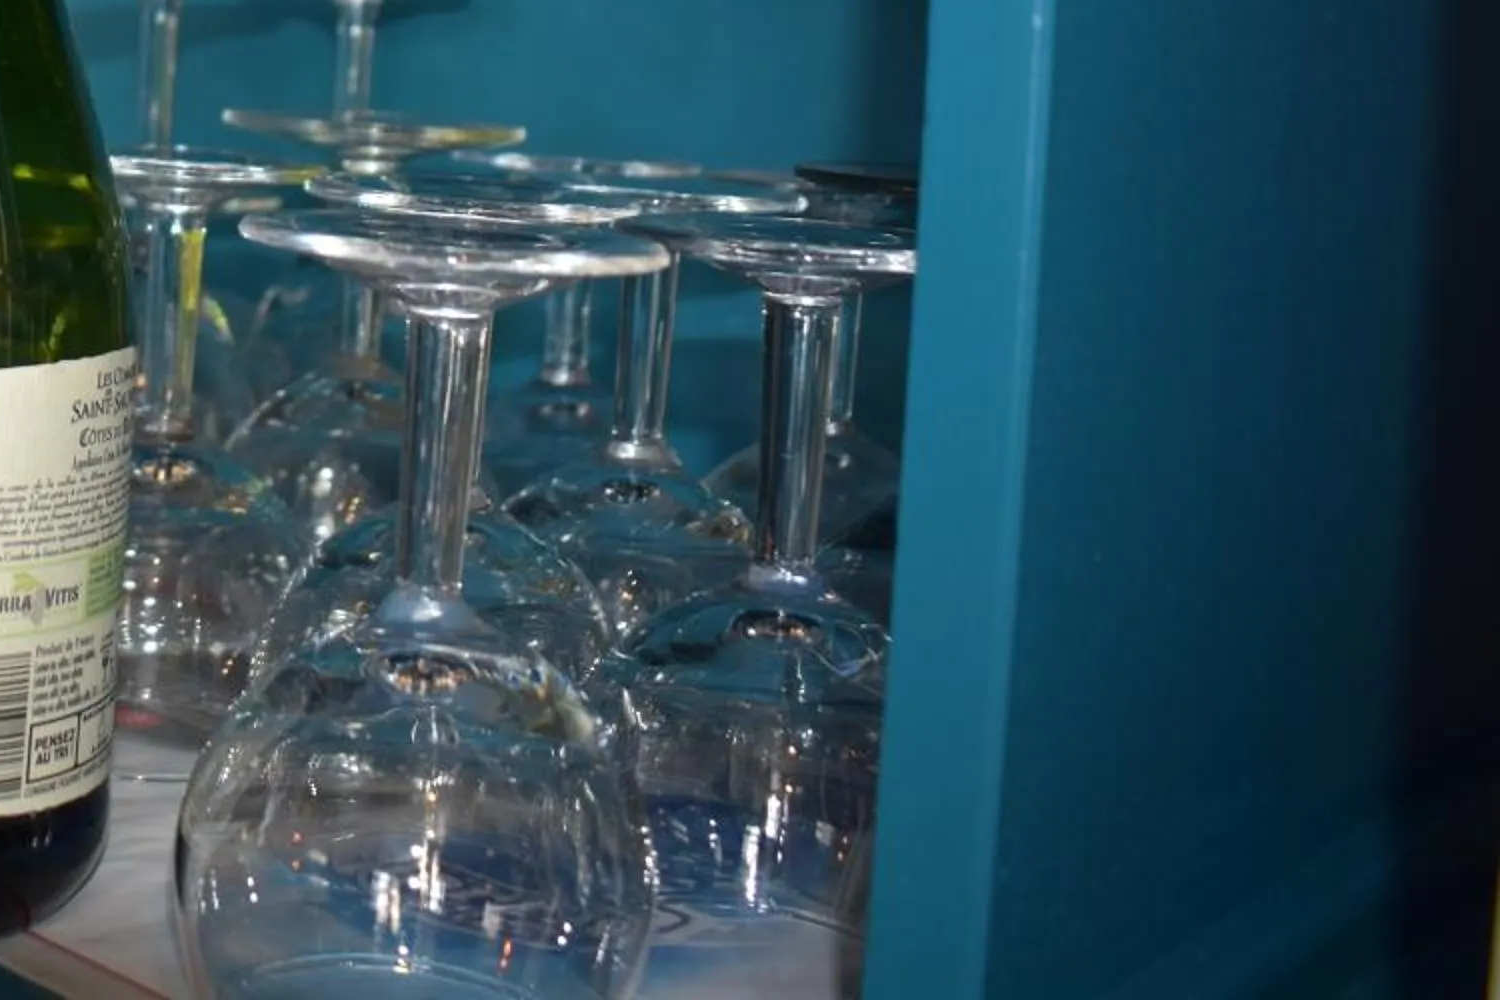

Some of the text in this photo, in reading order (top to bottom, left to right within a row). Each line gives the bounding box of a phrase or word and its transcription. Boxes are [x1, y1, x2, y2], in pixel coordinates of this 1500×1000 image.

[45, 586, 79, 608] VITIS
[34, 728, 76, 752] PENSEZ
[36, 752, 50, 765] AU
